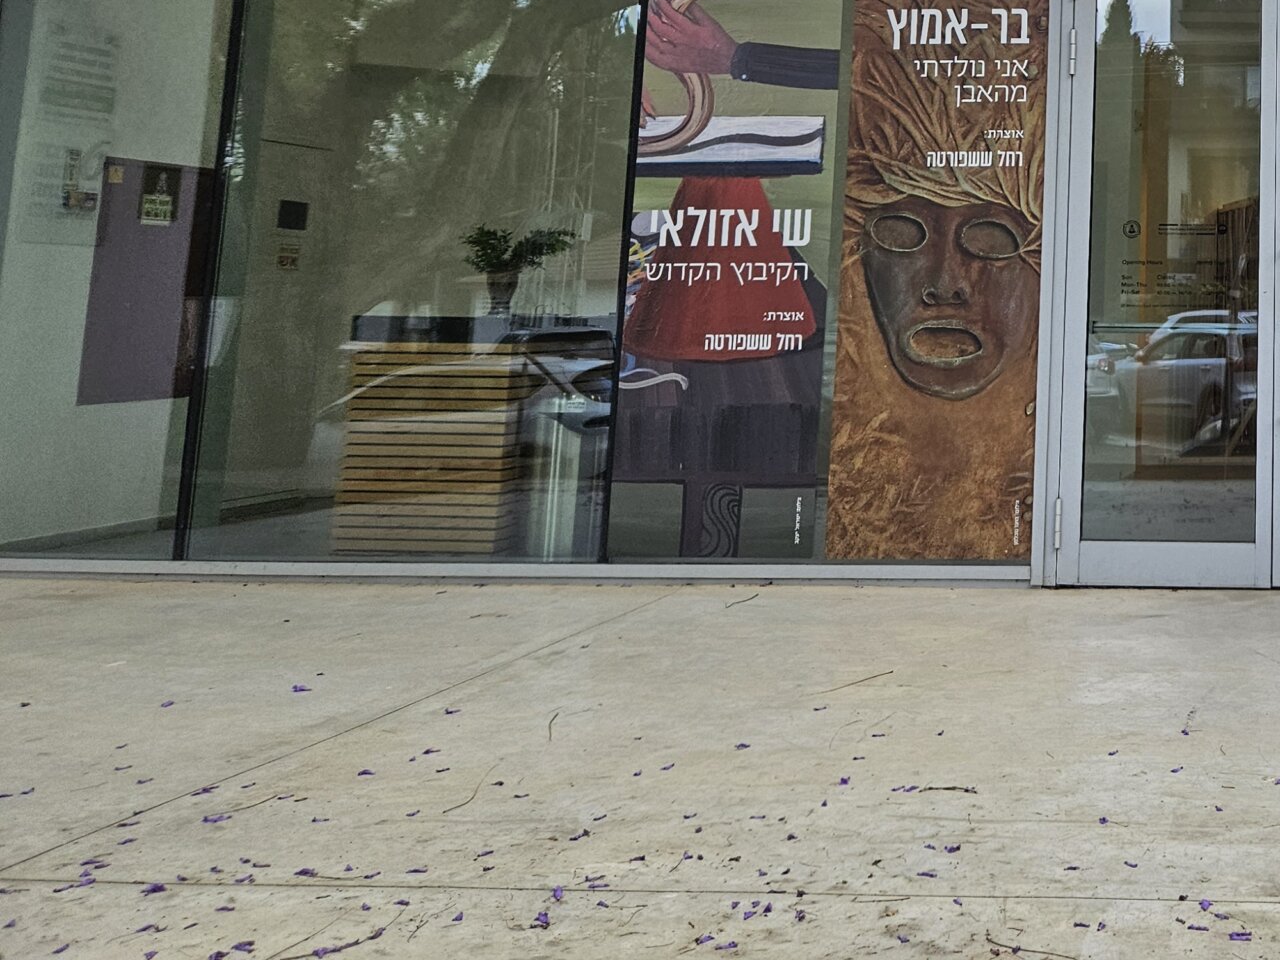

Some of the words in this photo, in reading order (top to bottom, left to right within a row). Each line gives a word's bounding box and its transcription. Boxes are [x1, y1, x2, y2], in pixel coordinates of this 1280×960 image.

[886, 7, 1030, 50] בר-אמוץ
[913, 55, 986, 78] נולדתי
[996, 59, 1029, 78] אני
[954, 84, 1027, 108] מהאבן
[983, 129, 1025, 139] אוצרת:
[926, 151, 993, 168] ששפורטה
[997, 150, 1024, 168] רחל
[649, 206, 760, 248] אזולאי
[772, 208, 813, 247] שי
[644, 262, 722, 286] הקדוש
[730, 262, 809, 286] הקיבוץ
[762, 311, 805, 322] אוצרת:
[703, 333, 772, 351] ששפורטה
[776, 332, 804, 351] רחל
